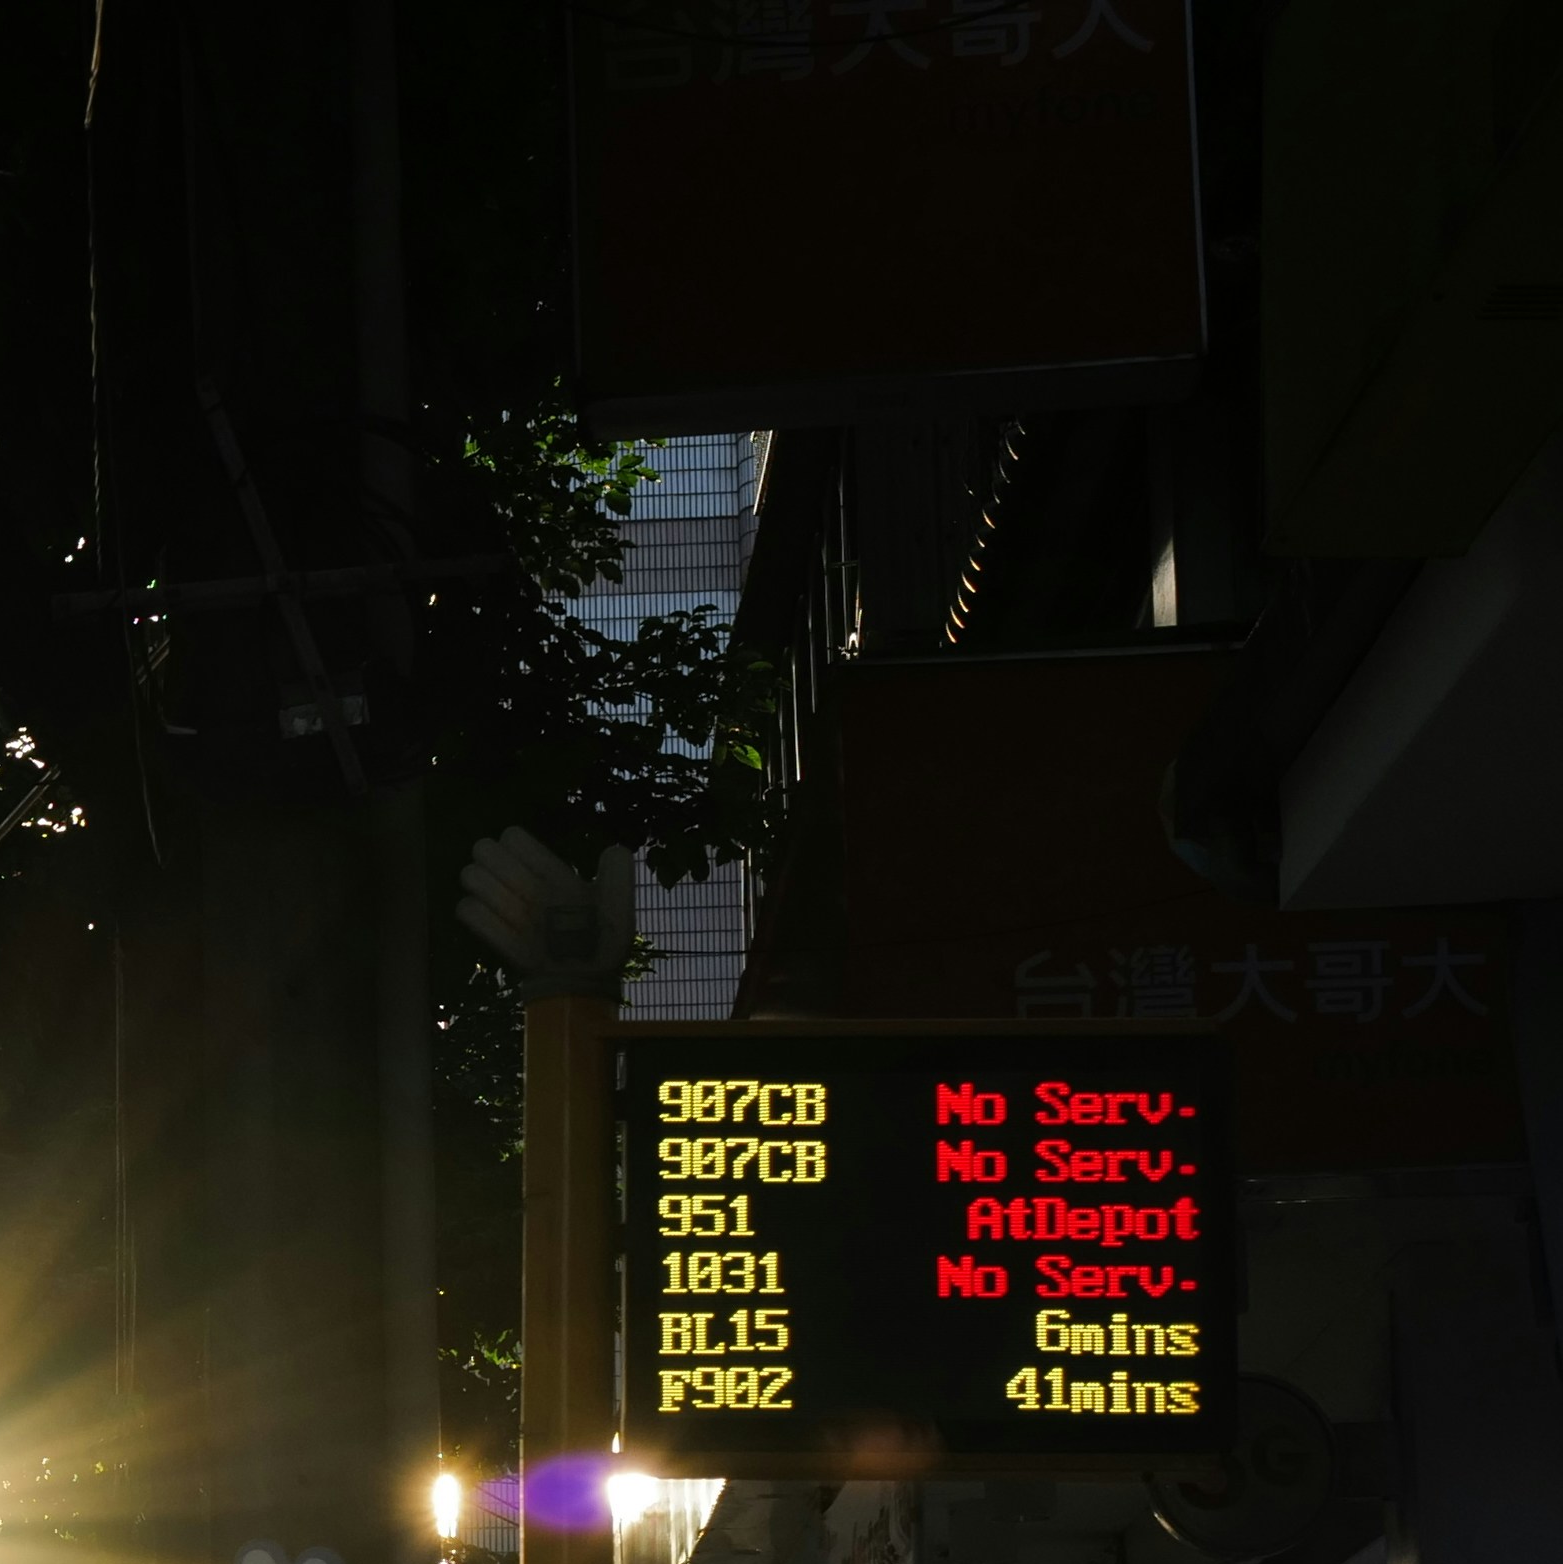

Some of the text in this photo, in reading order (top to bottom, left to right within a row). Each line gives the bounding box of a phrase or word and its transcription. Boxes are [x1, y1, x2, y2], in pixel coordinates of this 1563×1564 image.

[658, 1080, 1196, 1126] 907CB No Serv.
[658, 1137, 1196, 1183] 907CB No Serv.
[658, 1194, 1200, 1246] 951 AtDepot
[662, 1251, 1197, 1298] 1031 No Serv.
[658, 1308, 1200, 1356] BL15 6mins
[657, 1366, 1200, 1414] F902 41mins
